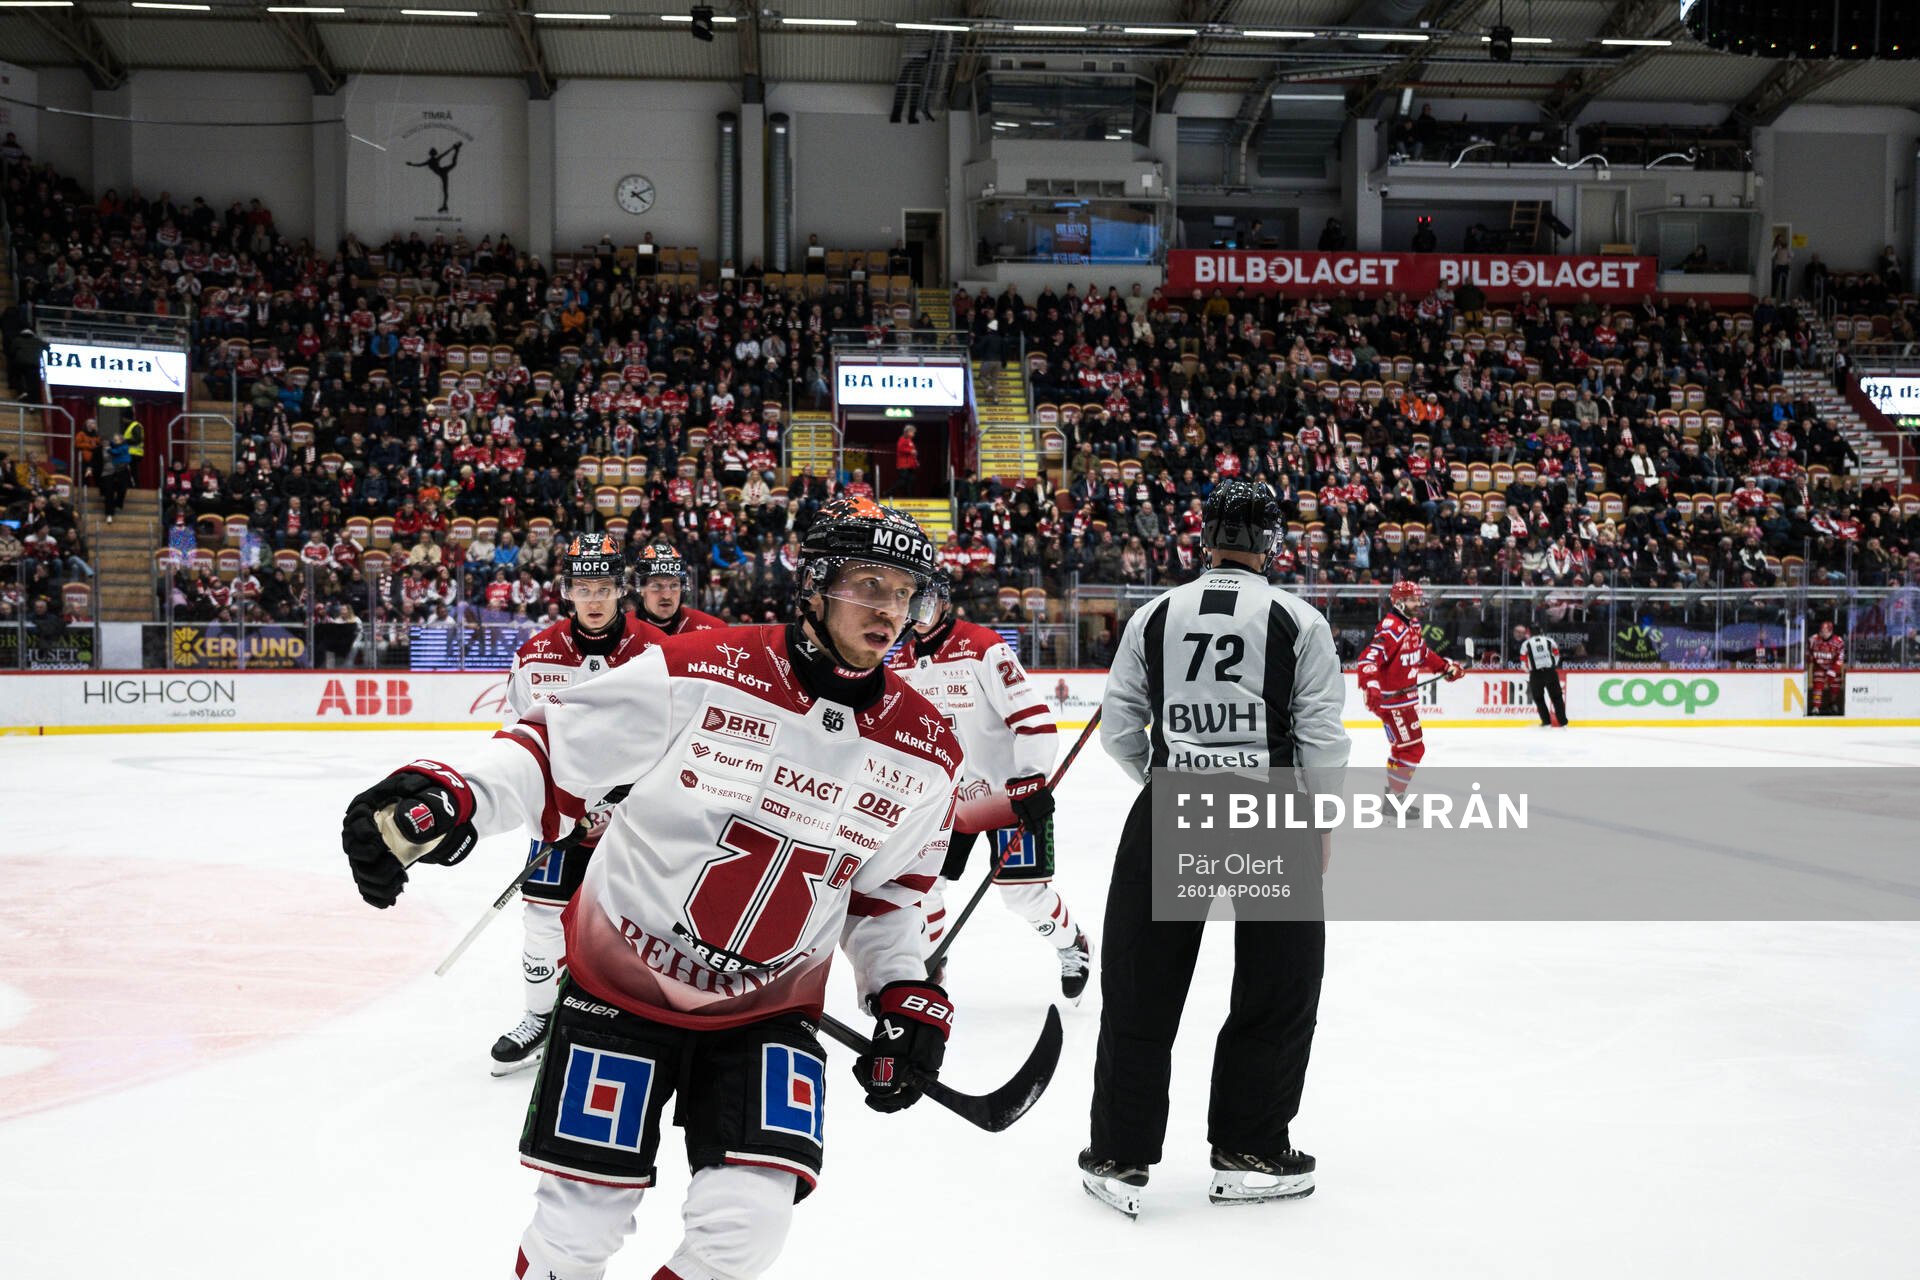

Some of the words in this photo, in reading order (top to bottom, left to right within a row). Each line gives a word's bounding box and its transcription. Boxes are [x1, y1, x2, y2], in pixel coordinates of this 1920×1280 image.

[1195, 256, 1400, 285] BILBOLAGET
[1439, 260, 1641, 288] BILBOLAGET
[47, 352, 81, 368] BA
[90, 355, 152, 372] data
[845, 374, 873, 388] BA
[881, 375, 933, 388] data
[1866, 384, 1892, 399] BA
[872, 528, 933, 561] MOFO
[572, 561, 610, 572] MOFO
[651, 563, 681, 571] MOFO
[1182, 632, 1245, 684] 72
[543, 674, 568, 682] BRL
[687, 661, 735, 680] NÄRKE
[737, 672, 772, 692] KÖTT
[942, 669, 971, 677] NASTA
[84, 680, 235, 704] HIGHCON
[316, 679, 413, 716] ABB
[946, 684, 968, 695] OBK
[1598, 678, 1720, 714] coop
[720, 716, 770, 739] BRL
[1168, 702, 1258, 734] BWH
[713, 751, 744, 768] four
[744, 759, 763, 773] fm
[894, 730, 933, 754] NÄRKE
[934, 746, 955, 770] KÖTT
[1174, 750, 1259, 773] Hotels
[773, 766, 843, 804] EXACT
[863, 758, 925, 794] NASTA
[701, 783, 717, 795] VVS
[717, 790, 753, 803] SERVICE
[1007, 782, 1039, 798] UER
[763, 800, 787, 817] ONE
[789, 810, 832, 831] PROFILE
[857, 792, 906, 823] OBK
[828, 855, 860, 889] A
[679, 932, 757, 972] ÖREB
[563, 996, 620, 1019] BAUER
